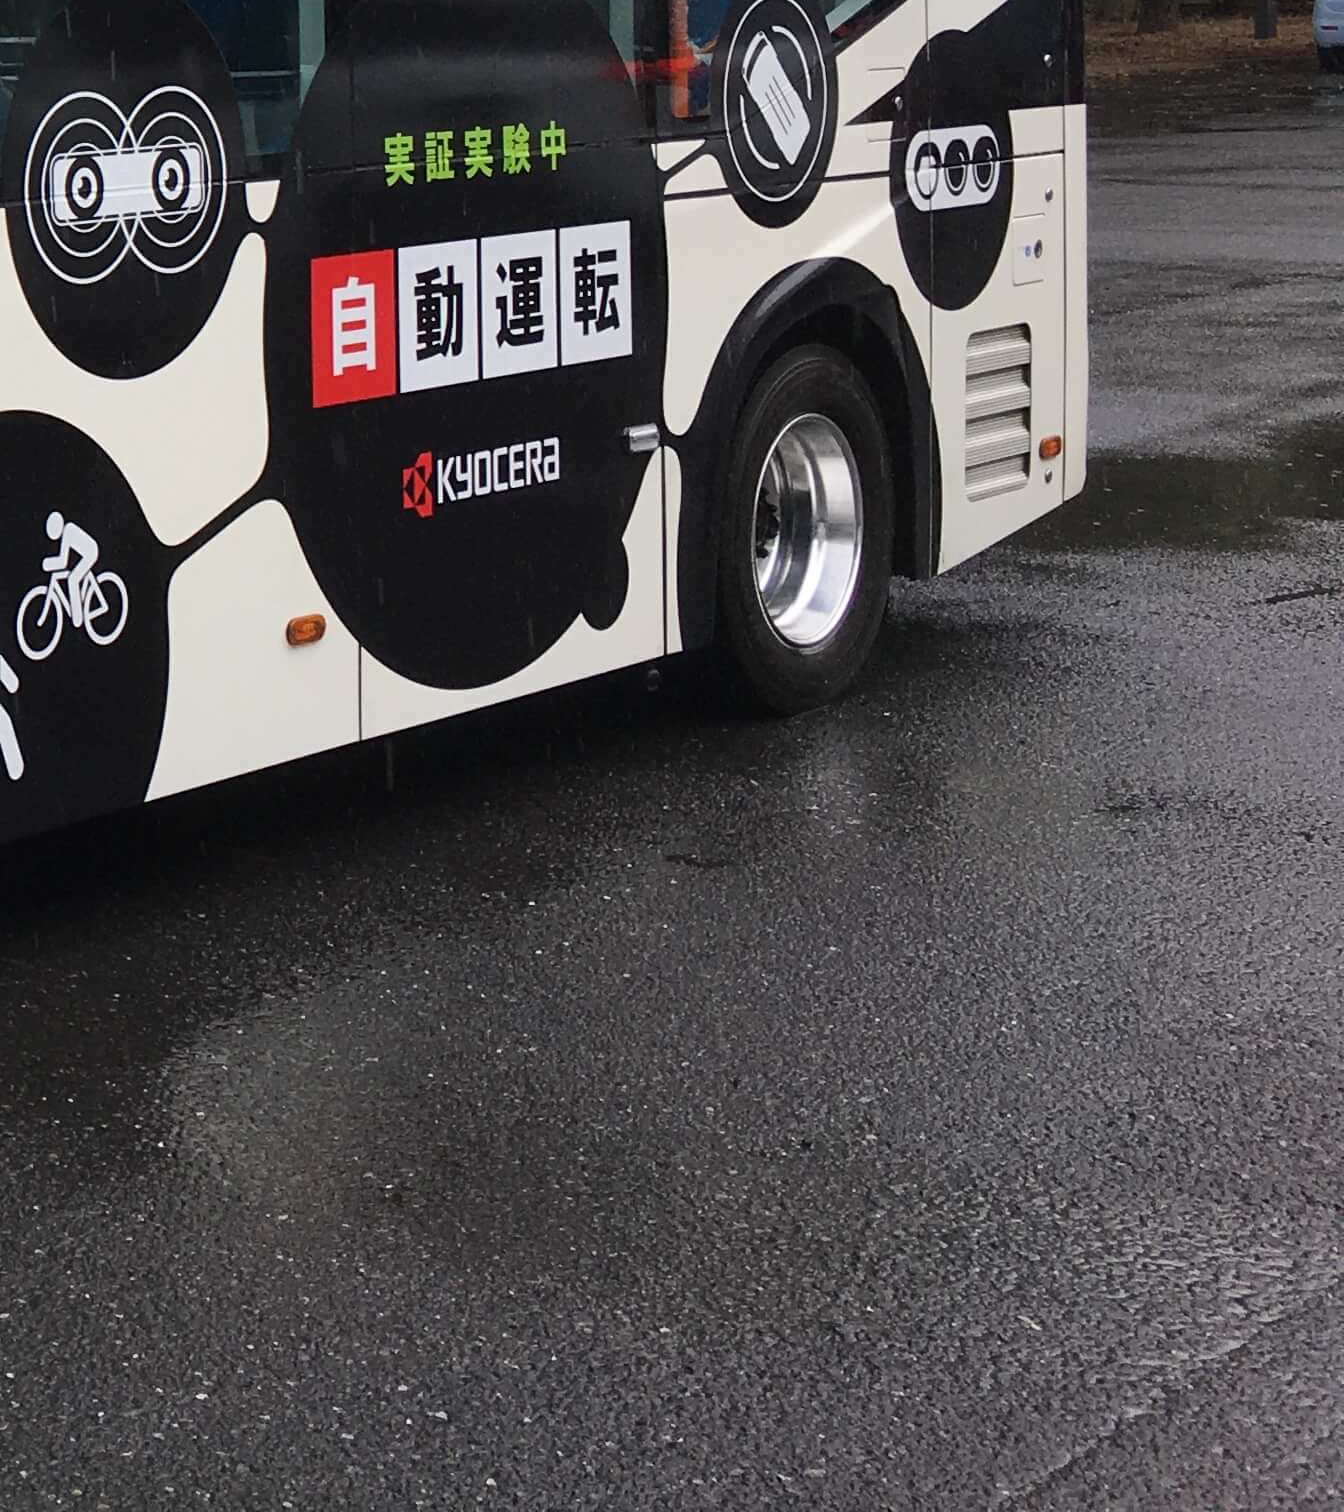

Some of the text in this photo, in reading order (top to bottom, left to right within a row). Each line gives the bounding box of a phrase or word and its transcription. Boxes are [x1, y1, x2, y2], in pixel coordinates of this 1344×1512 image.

[384, 120, 567, 187] 実証実験中
[331, 248, 621, 377] 自動運転
[437, 437, 560, 504] KYOCERA
